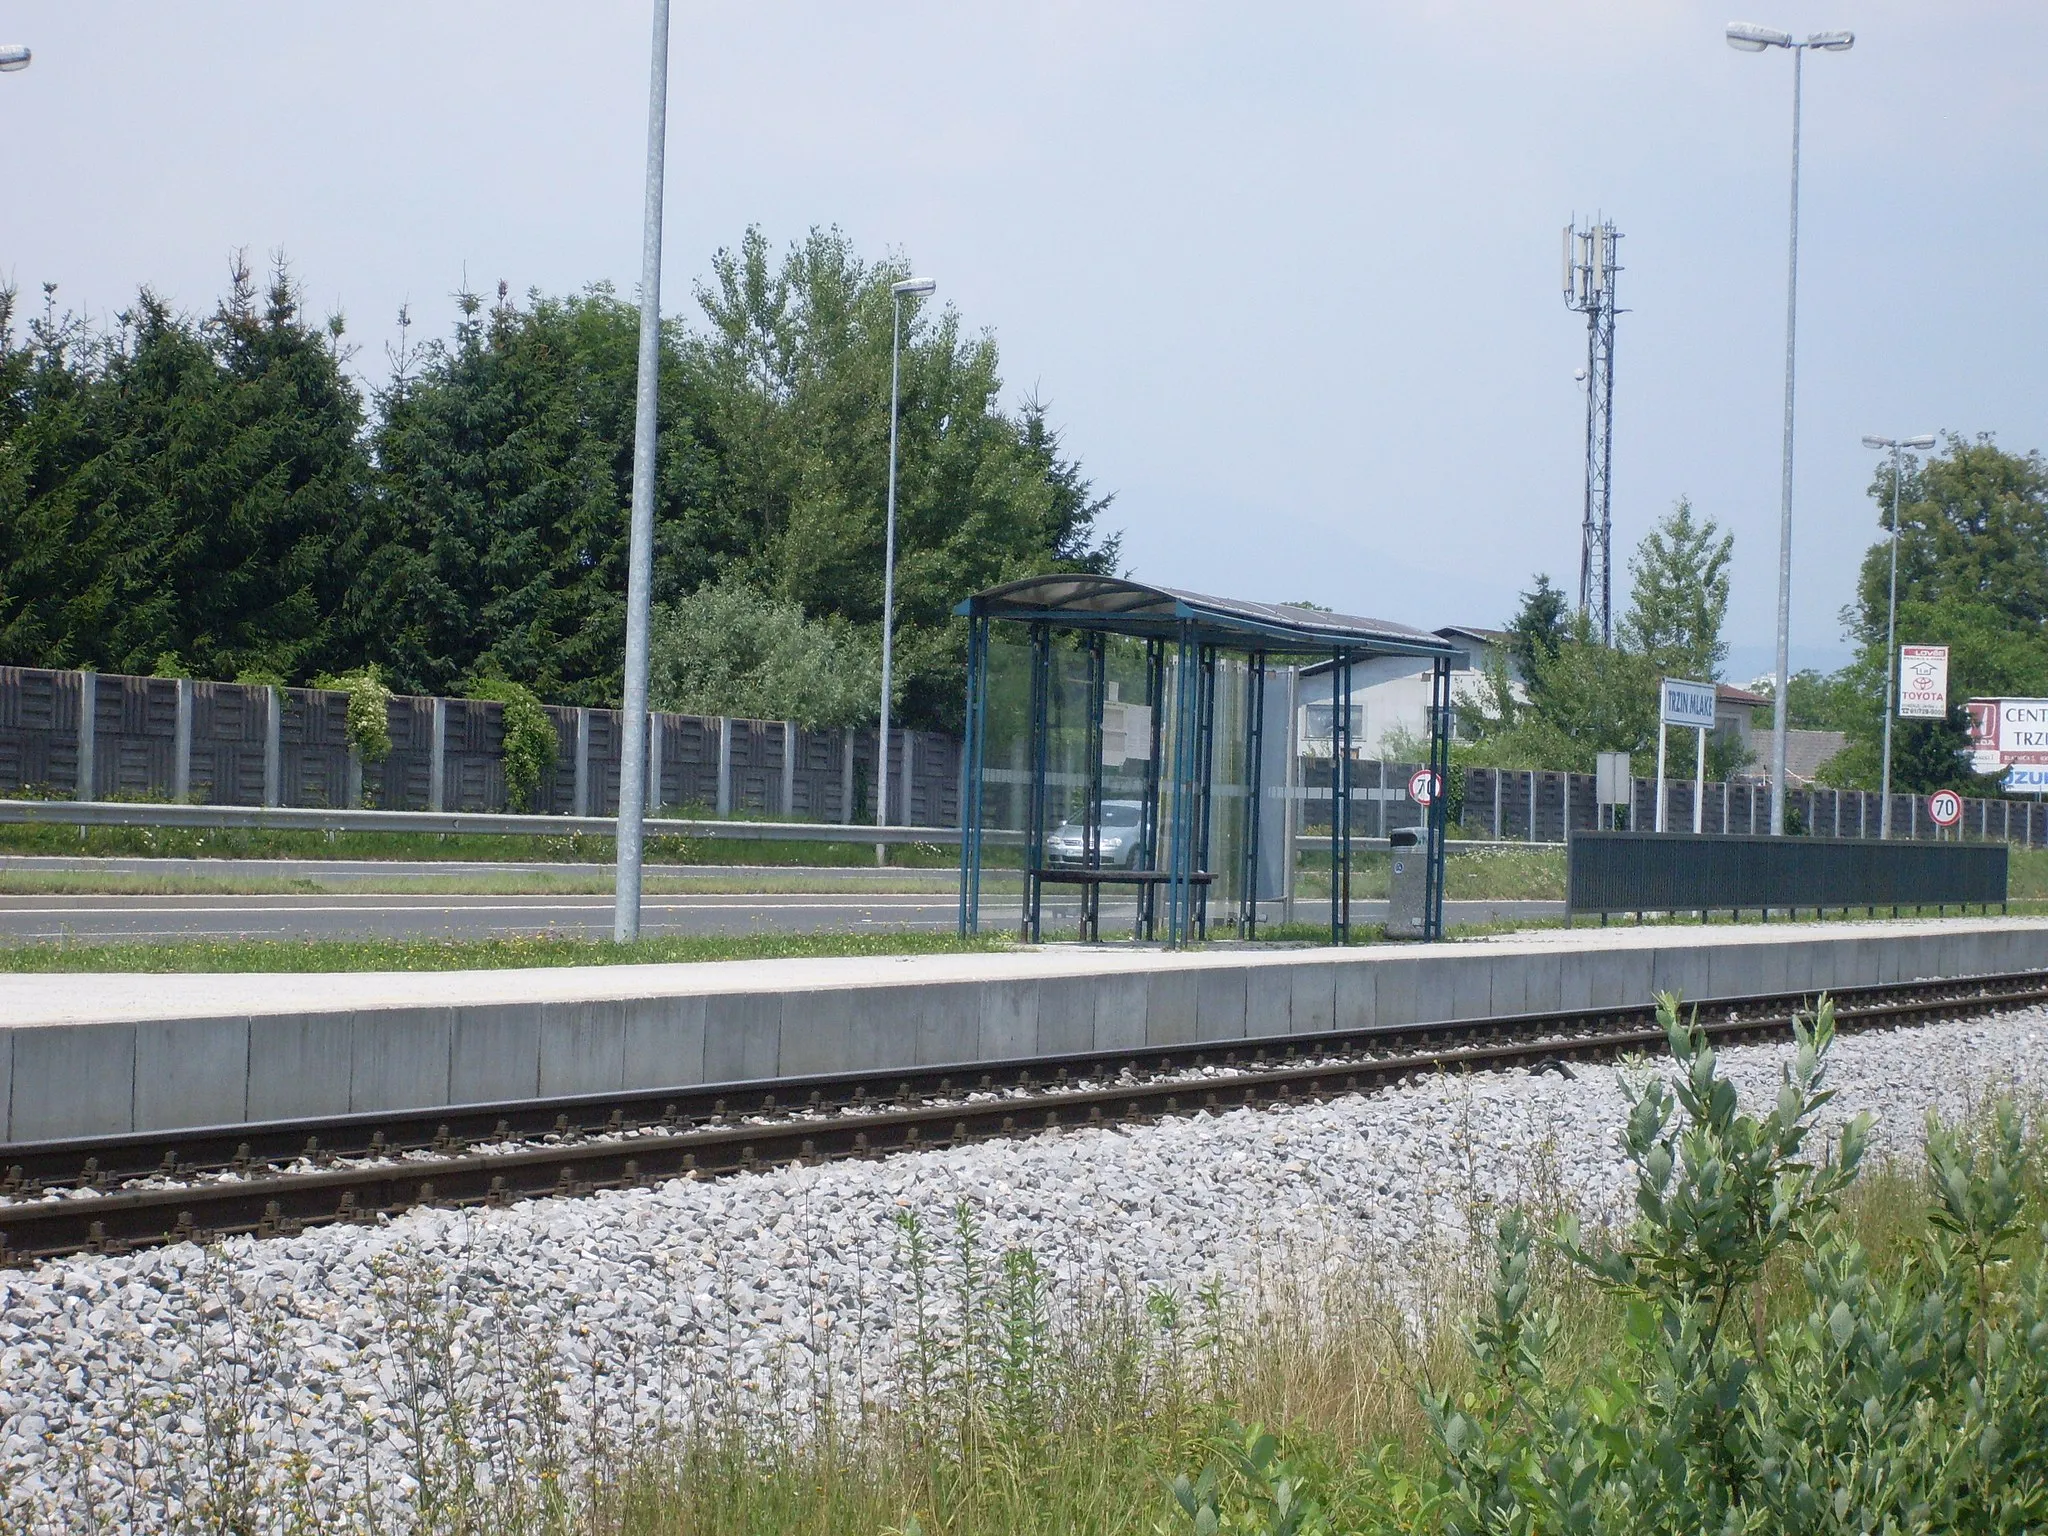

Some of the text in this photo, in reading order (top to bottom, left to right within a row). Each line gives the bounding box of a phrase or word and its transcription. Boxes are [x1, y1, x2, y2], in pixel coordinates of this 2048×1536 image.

[1668, 690, 1712, 717] TRZIN MLAKE
[1902, 692, 1943, 701] TOYOTA
[1936, 799, 1954, 816] 70
